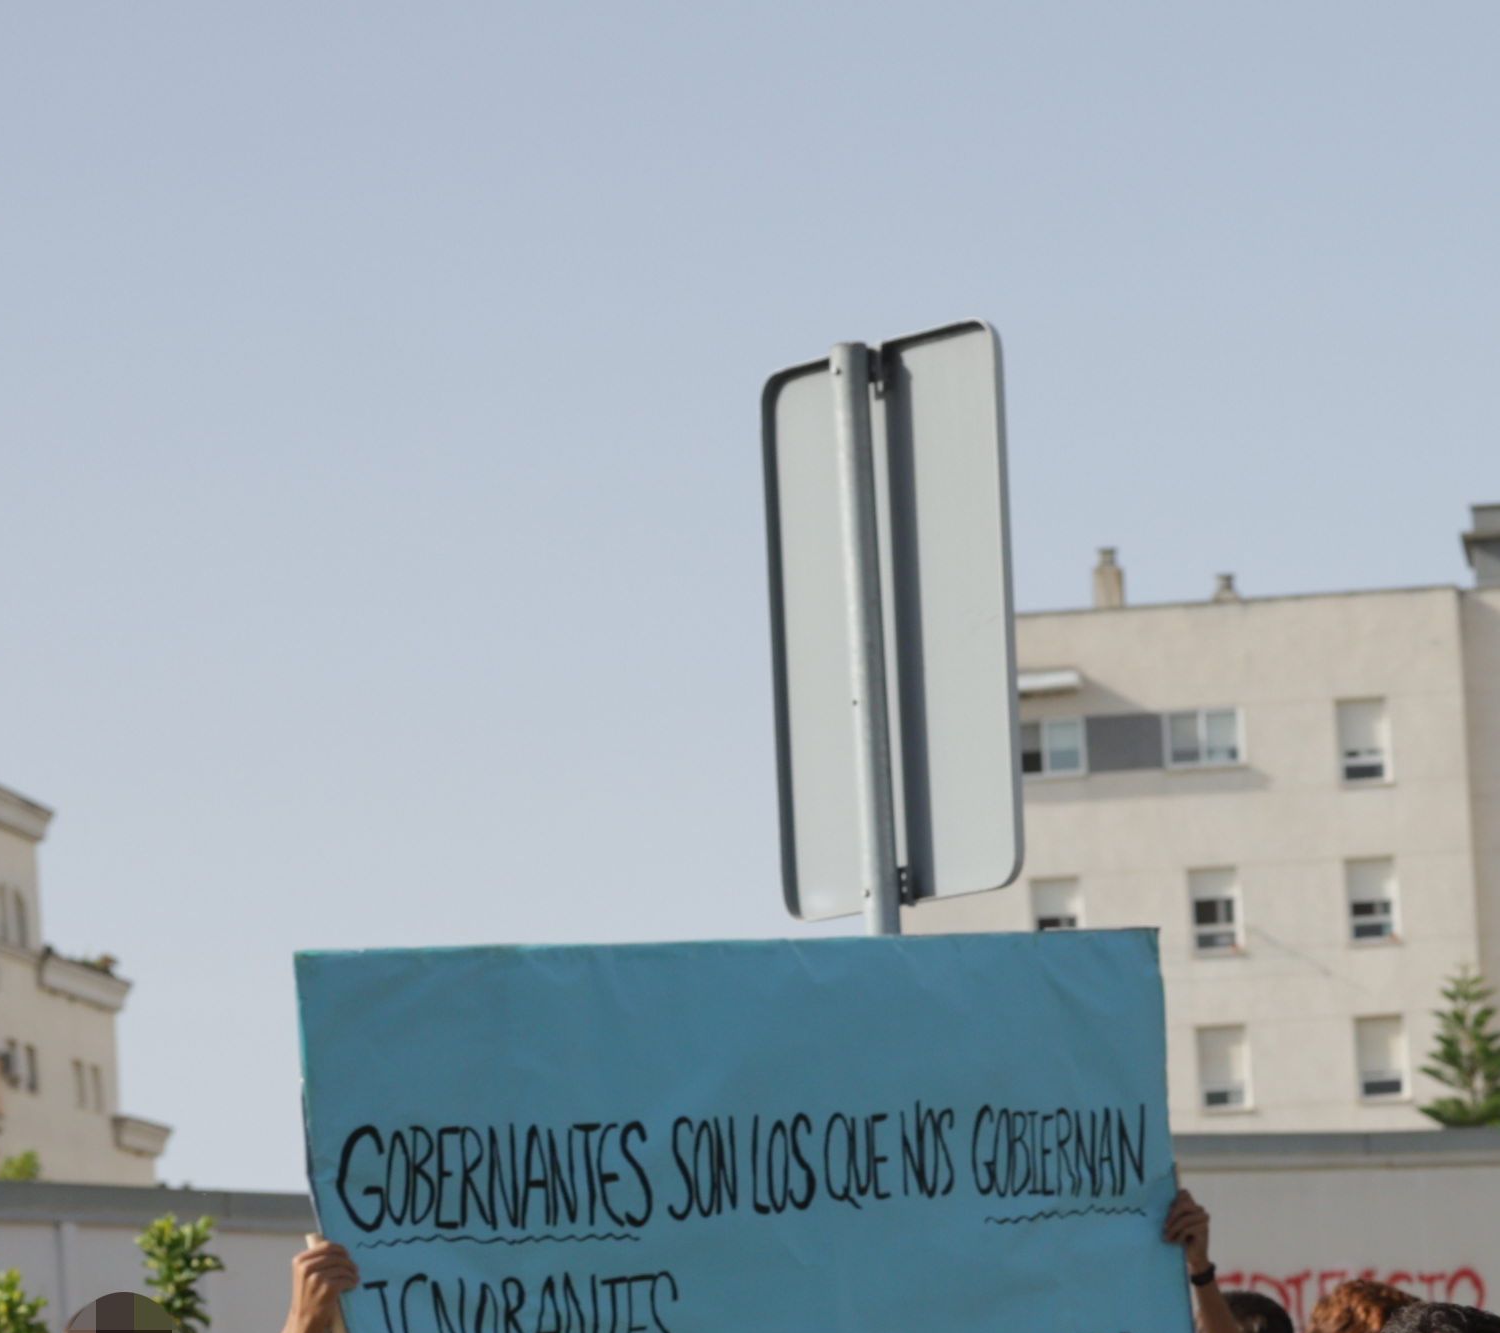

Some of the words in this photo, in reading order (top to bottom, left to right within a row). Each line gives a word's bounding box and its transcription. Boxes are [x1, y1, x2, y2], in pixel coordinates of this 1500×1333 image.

[336, 1120, 653, 1232] GOBERNANTES
[668, 1115, 739, 1221] SON
[752, 1112, 817, 1215] LOS
[824, 1112, 891, 1209] QUE
[900, 1100, 955, 1198] NOS
[971, 1103, 1146, 1199] GOBIERNAN
